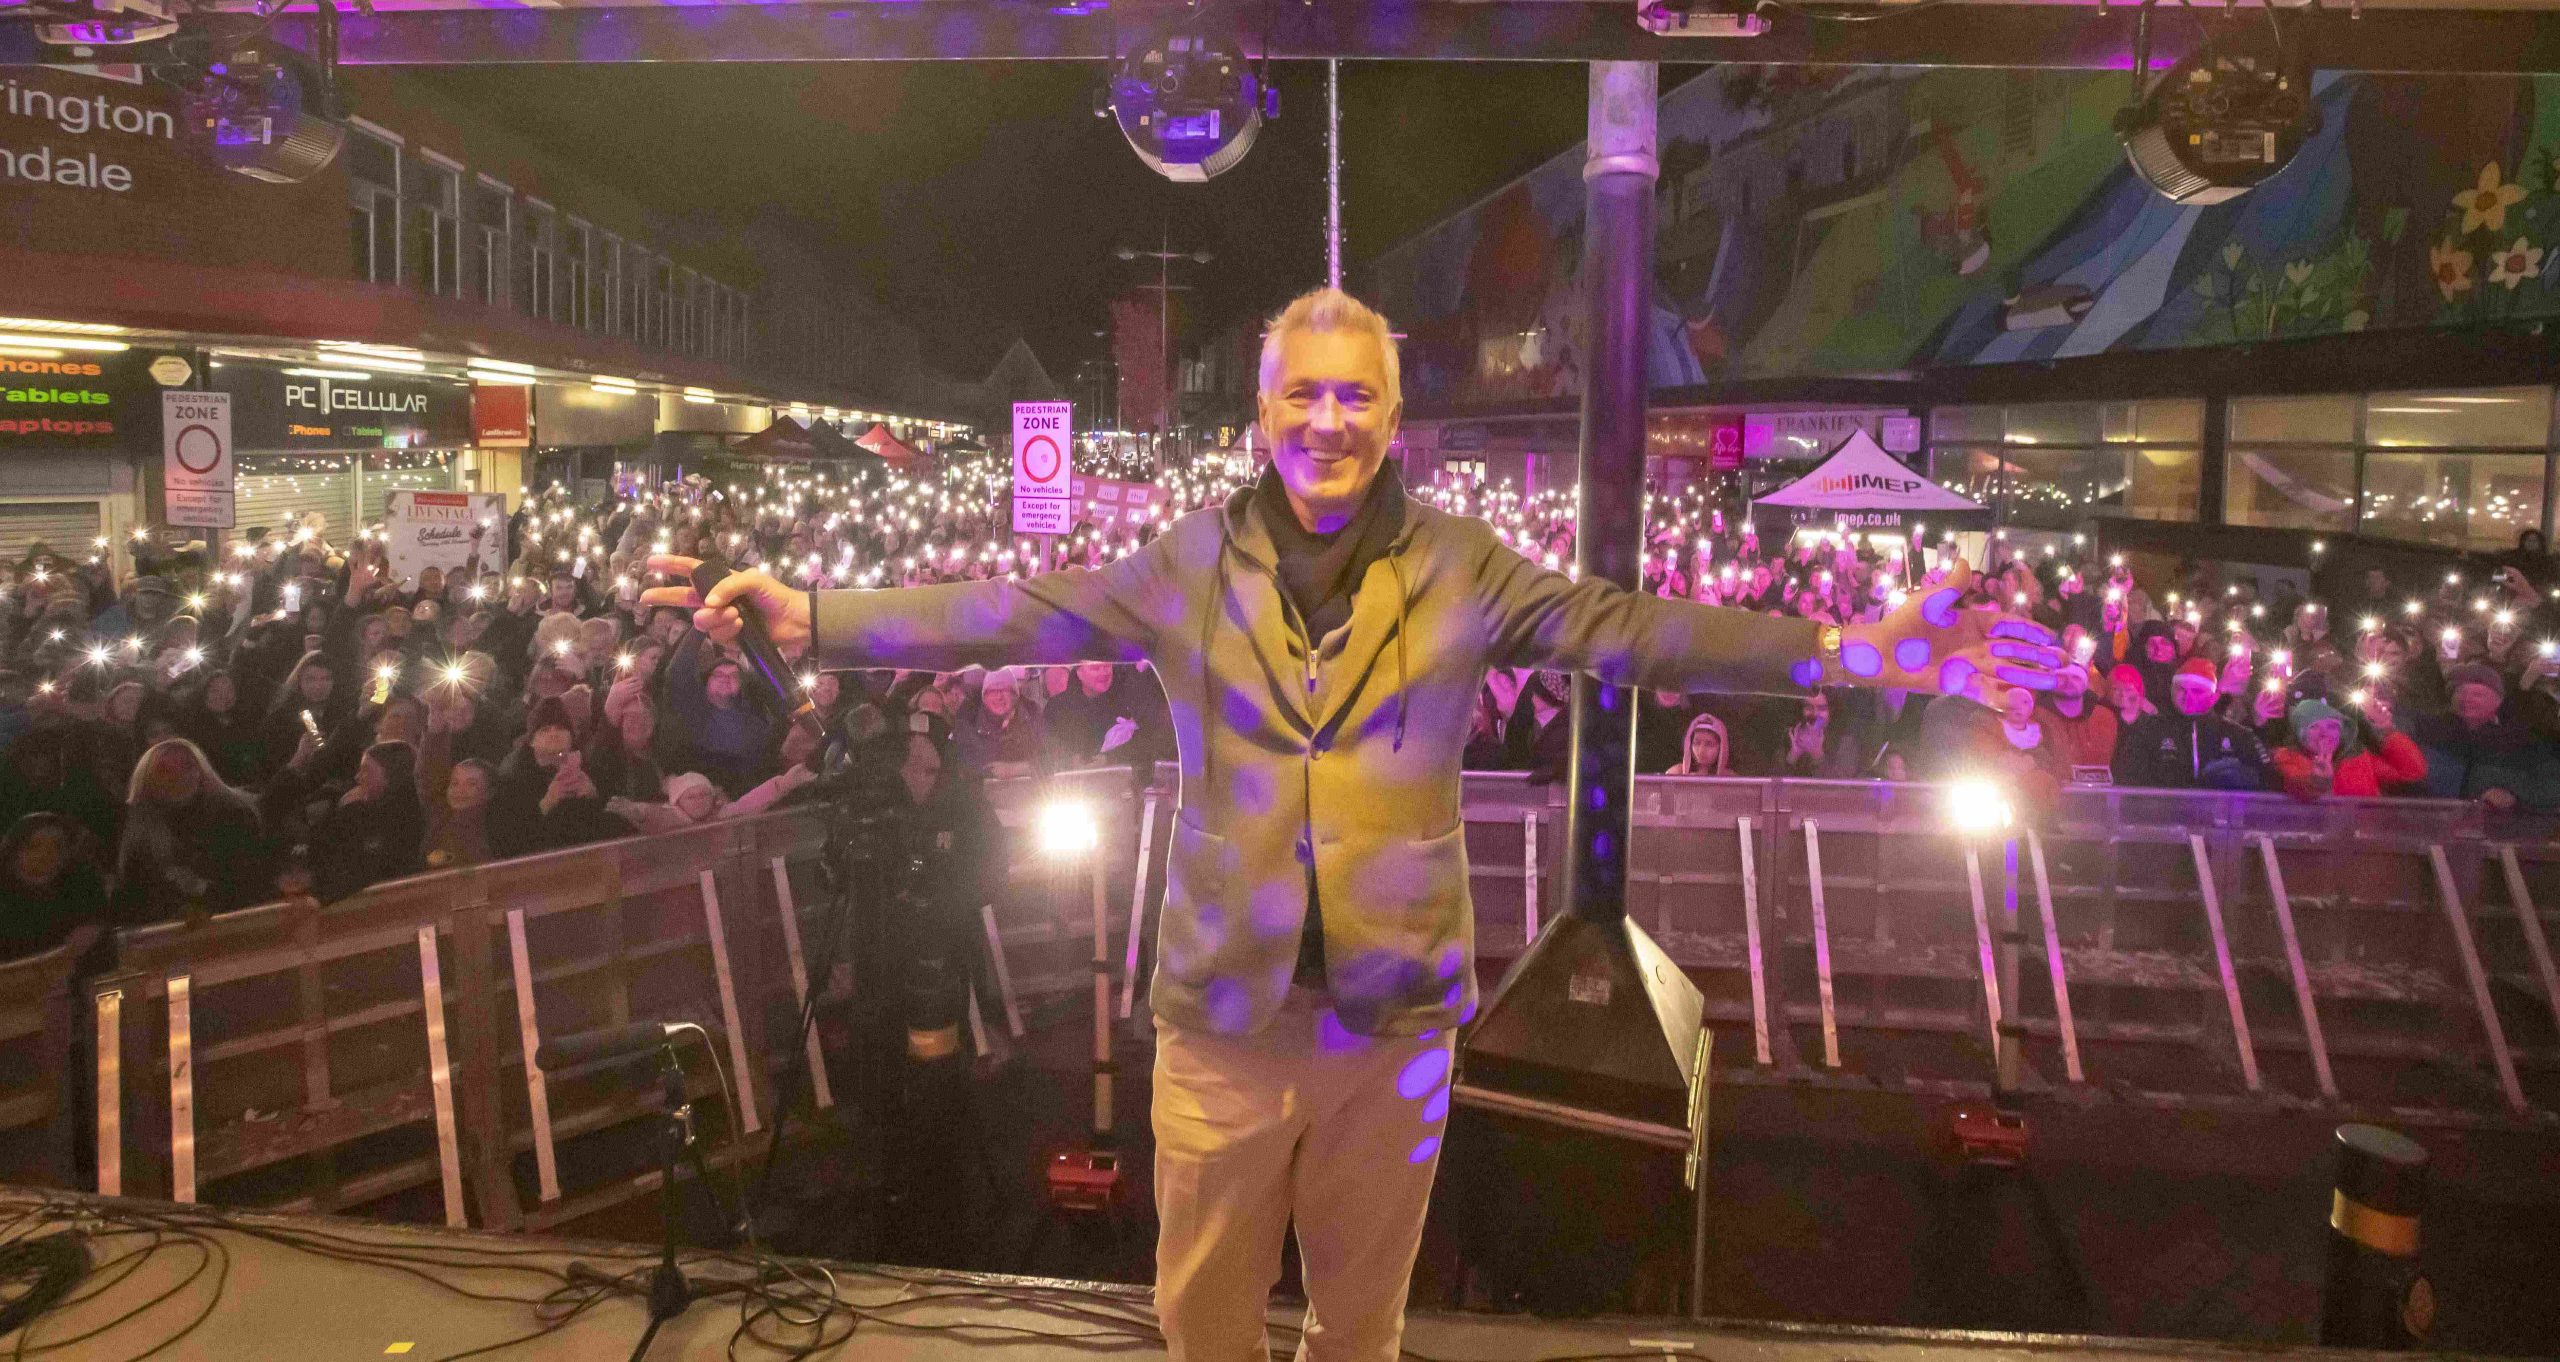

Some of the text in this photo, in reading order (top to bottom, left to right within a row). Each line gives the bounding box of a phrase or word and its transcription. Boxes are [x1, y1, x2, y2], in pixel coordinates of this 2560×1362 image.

[0, 79, 174, 139] ington
[166, 393, 228, 404] PEDESTRIAN
[286, 385, 427, 413] PC CELLULAR
[175, 405, 219, 420] ZONE
[1015, 405, 1068, 414] PEDESTRIAN
[1023, 417, 1060, 430] ZONE
[1020, 485, 1031, 493] No
[1032, 485, 1063, 494] vehicles
[1022, 501, 1060, 510] Except for
[1022, 513, 1061, 521] emergency
[1026, 521, 1056, 529] vehicles
[417, 525, 462, 541] Schedule
